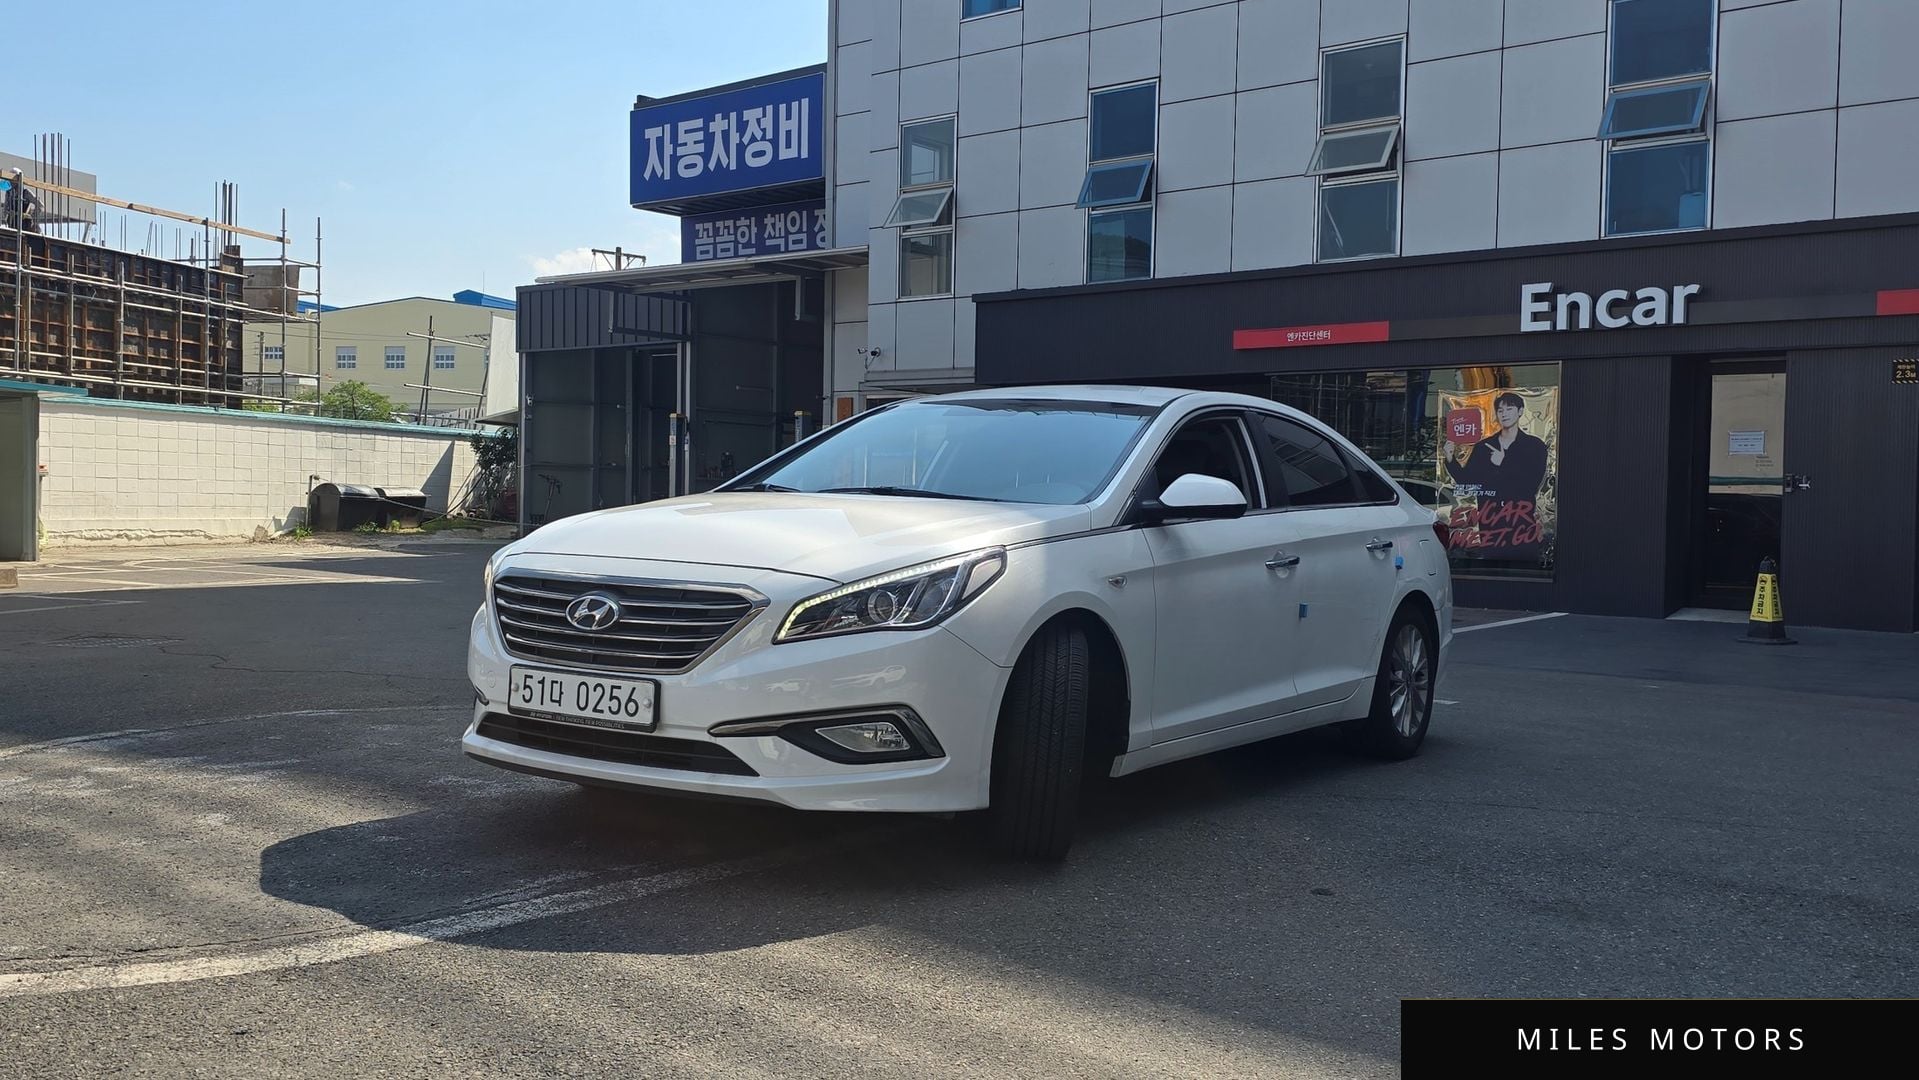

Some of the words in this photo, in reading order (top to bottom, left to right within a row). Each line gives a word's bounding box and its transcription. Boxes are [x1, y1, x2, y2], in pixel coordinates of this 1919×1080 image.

[643, 97, 809, 181] 자동차정비
[695, 216, 757, 261] 꼼꼼한
[764, 210, 808, 252] 책임
[1520, 282, 1700, 333] Encar
[1286, 329, 1331, 342] 엔카진단센터
[1453, 423, 1477, 437] 엔카
[522, 674, 564, 707] 51다
[576, 681, 640, 718] 0256
